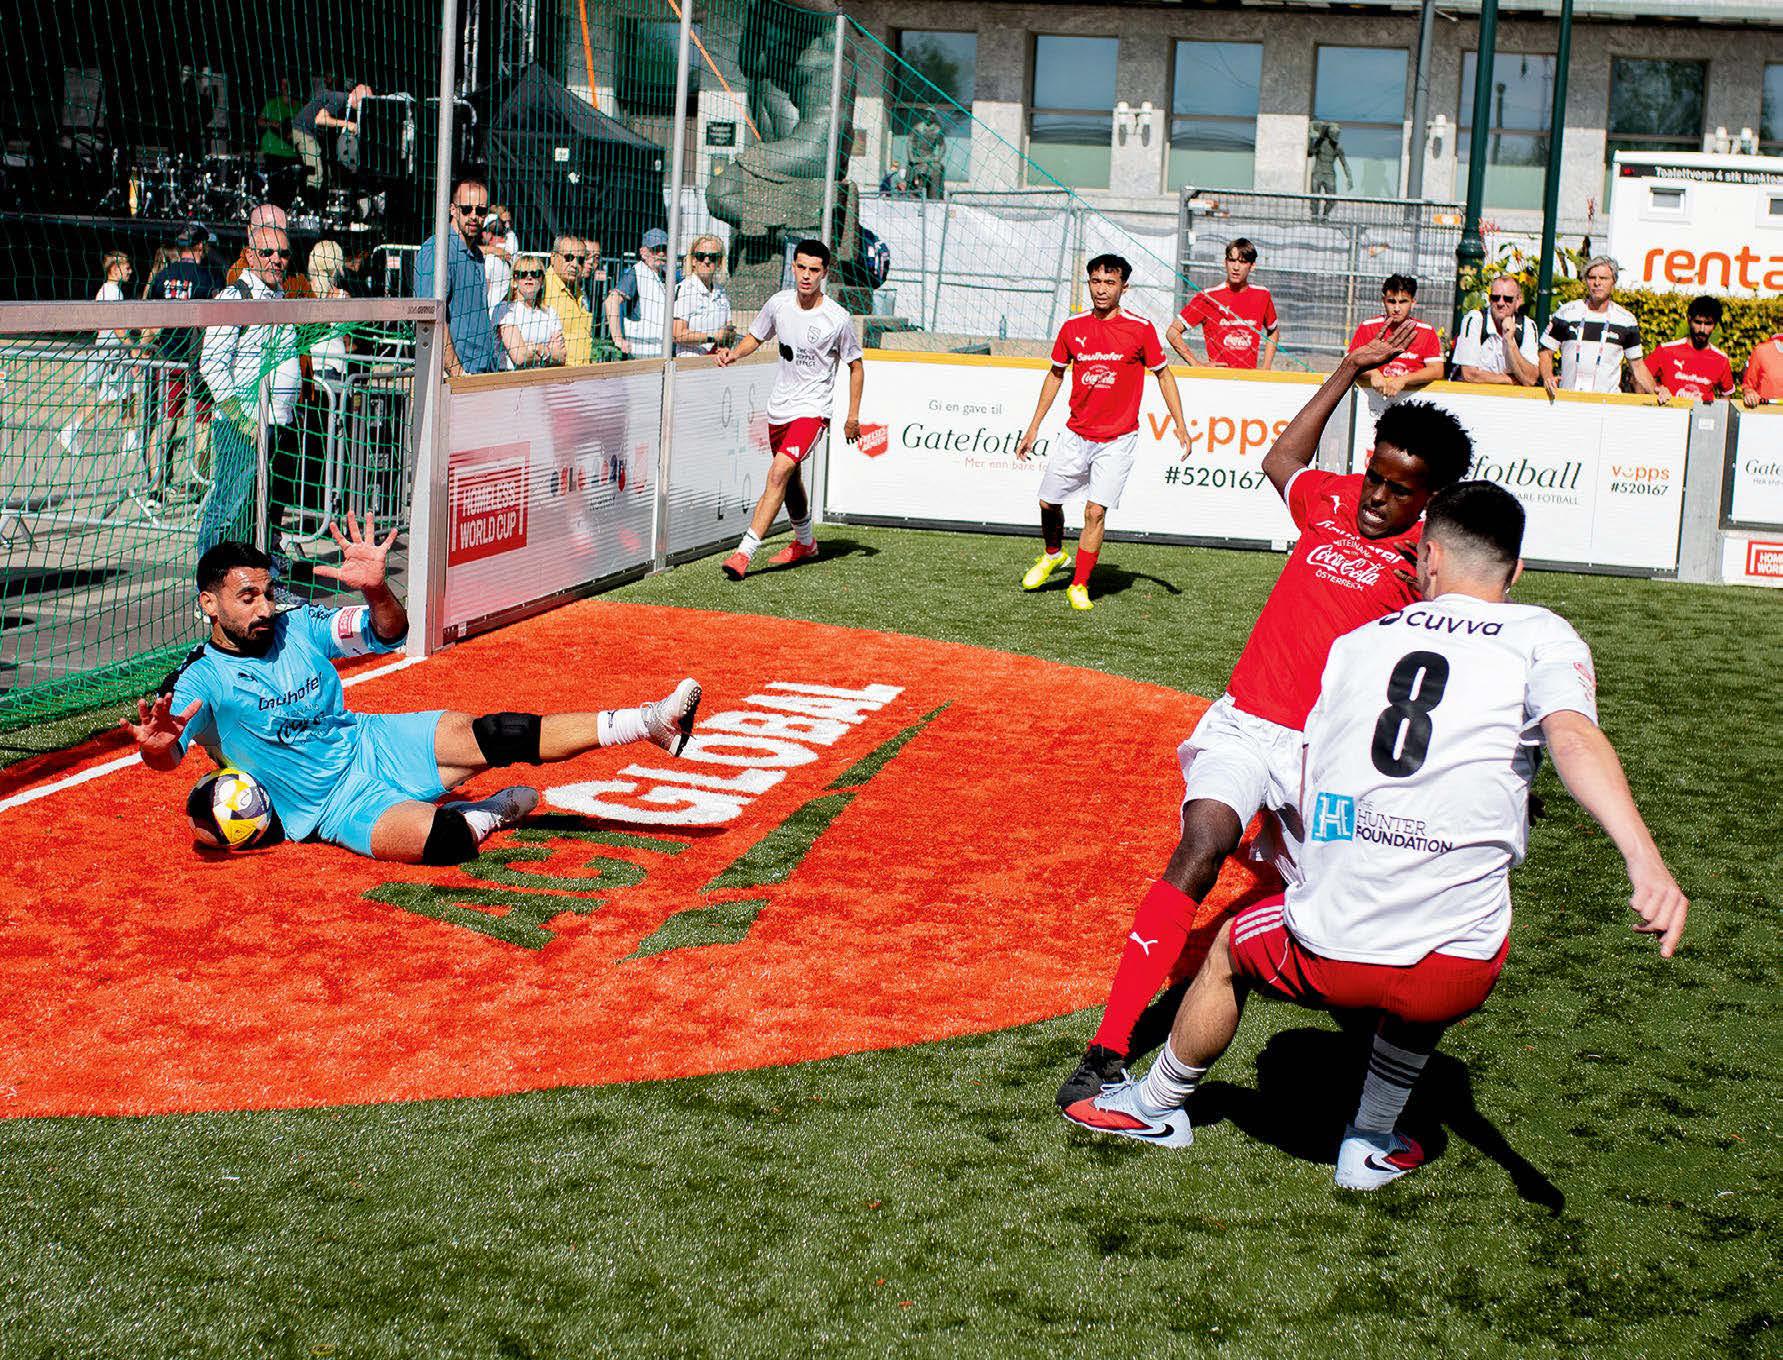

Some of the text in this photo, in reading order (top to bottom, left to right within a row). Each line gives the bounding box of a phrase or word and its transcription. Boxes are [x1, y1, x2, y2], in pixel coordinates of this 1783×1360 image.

[1716, 169, 1723, 181] 4
[1725, 170, 1741, 183] stk
[945, 404, 960, 412] en
[962, 405, 987, 416] gave
[991, 405, 1003, 415] til
[1164, 466, 1267, 490] #520167
[1464, 455, 1582, 489] fotball
[462, 482, 516, 517] HOMELESS
[1611, 482, 1669, 496] #520167
[460, 511, 517, 549] WORLD CUP
[1370, 650, 1450, 778] 8
[544, 682, 906, 827] GLOBAL
[1357, 808, 1427, 836] HUNTER
[1355, 825, 1454, 853] FOUNDATION
